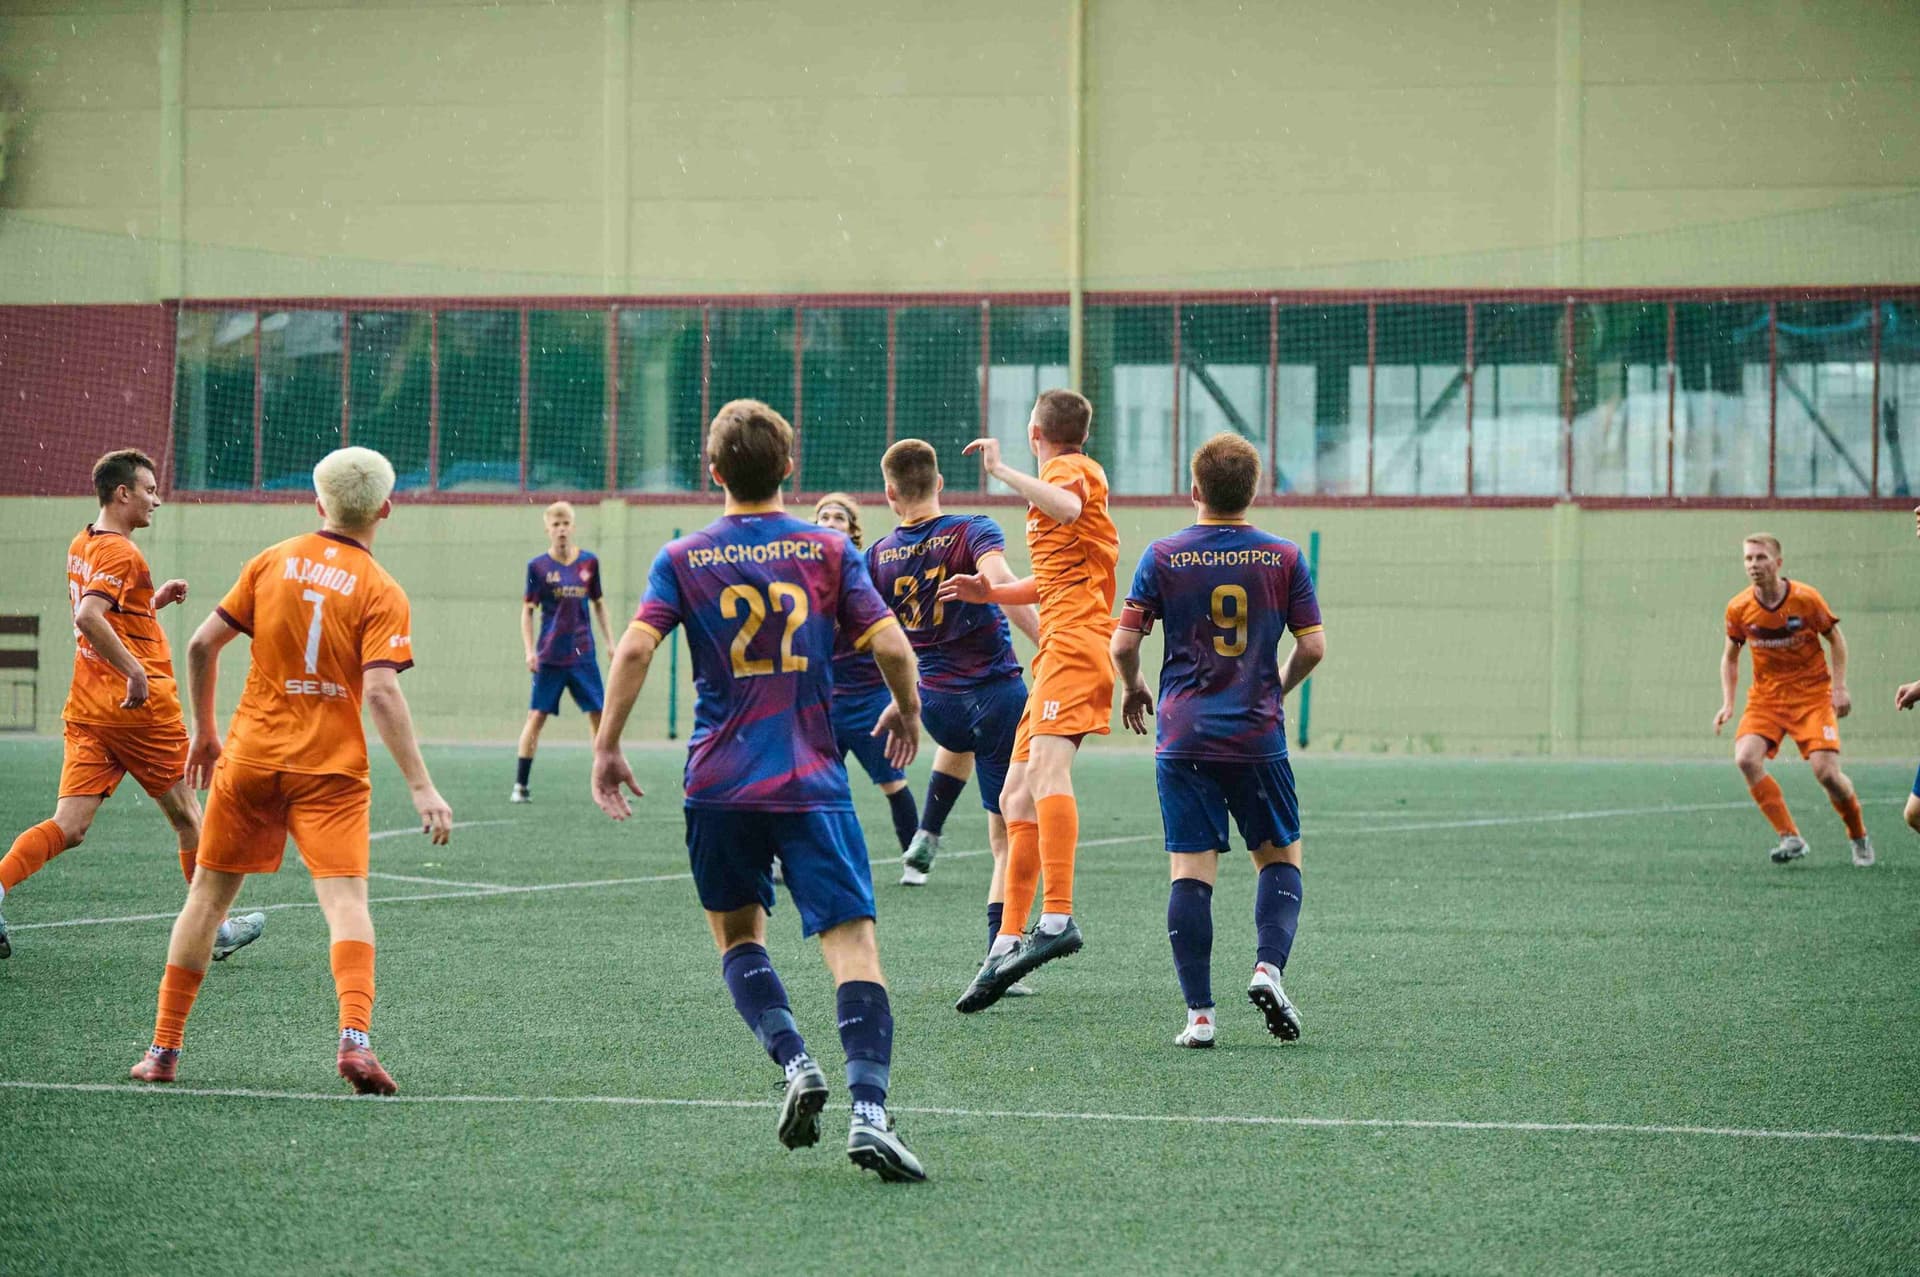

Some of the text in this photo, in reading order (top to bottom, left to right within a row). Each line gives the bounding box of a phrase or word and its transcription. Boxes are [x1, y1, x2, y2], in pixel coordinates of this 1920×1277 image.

[283, 557, 358, 596] ЖДАНОВ
[687, 540, 824, 568] КРАСНОЯРСК
[1170, 550, 1283, 568] КРАСНОЯРСК
[719, 581, 809, 679] 22
[894, 563, 948, 631] 37
[1211, 584, 1248, 657] 9
[302, 589, 326, 674] 7
